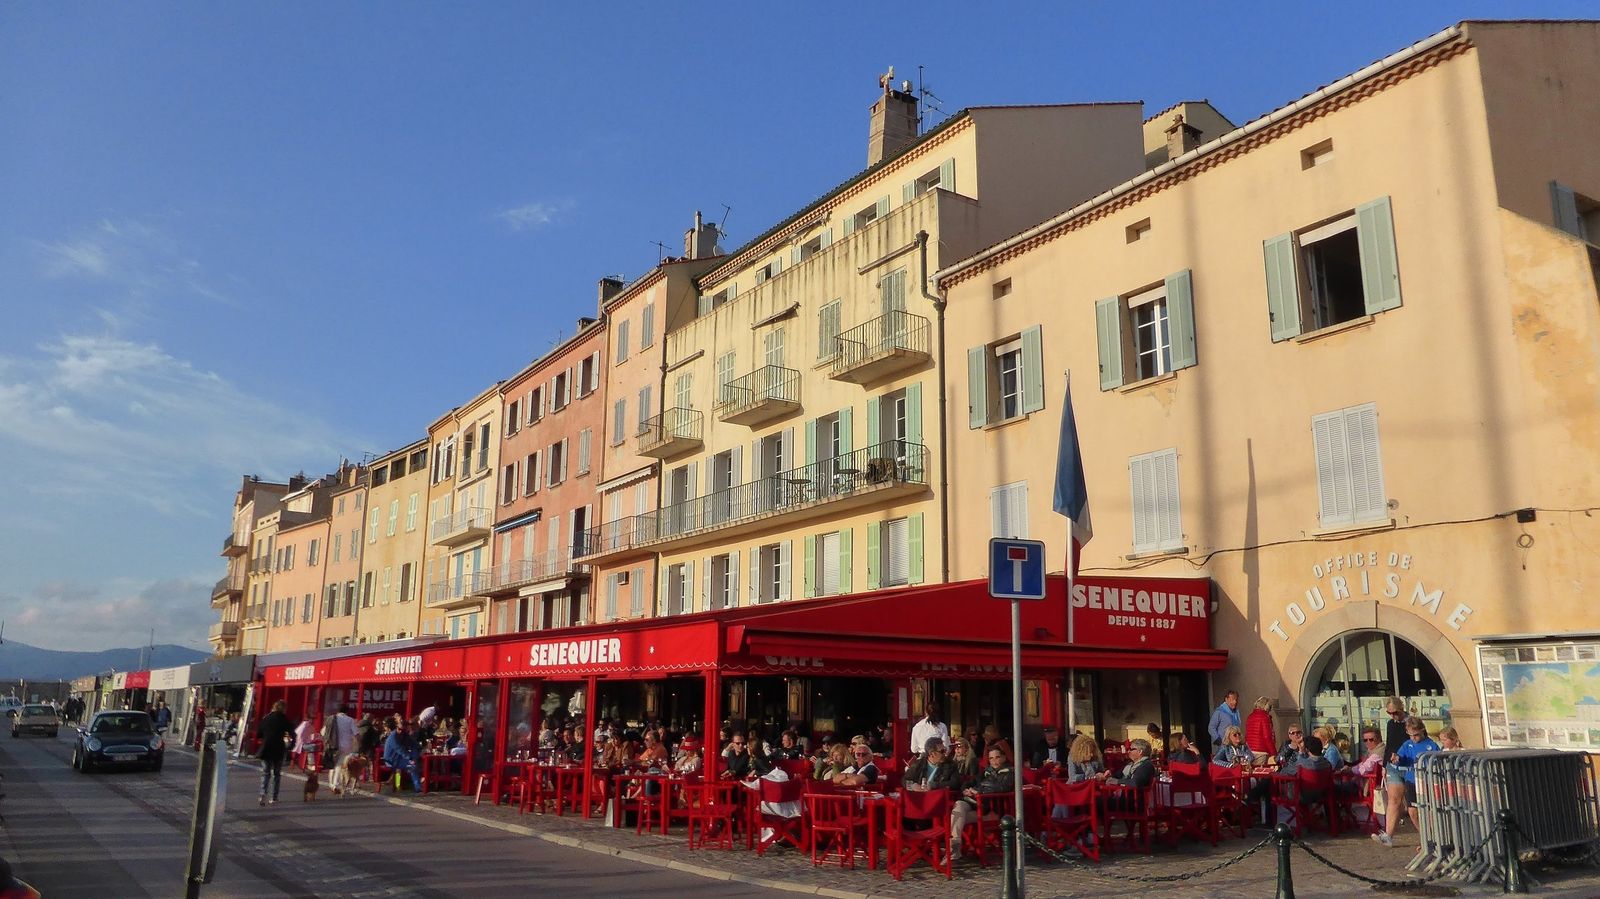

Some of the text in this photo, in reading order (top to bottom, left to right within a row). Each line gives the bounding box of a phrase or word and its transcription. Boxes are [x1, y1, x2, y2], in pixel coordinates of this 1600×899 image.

[1311, 552, 1413, 579] OFFICE DE
[1072, 584, 1206, 618] SENEQUIER
[1267, 569, 1474, 642] TOURISME
[1108, 614, 1176, 630] DEPUIS 1887
[374, 655, 422, 675] SENEQUIER
[529, 637, 621, 667] SENEQUIER
